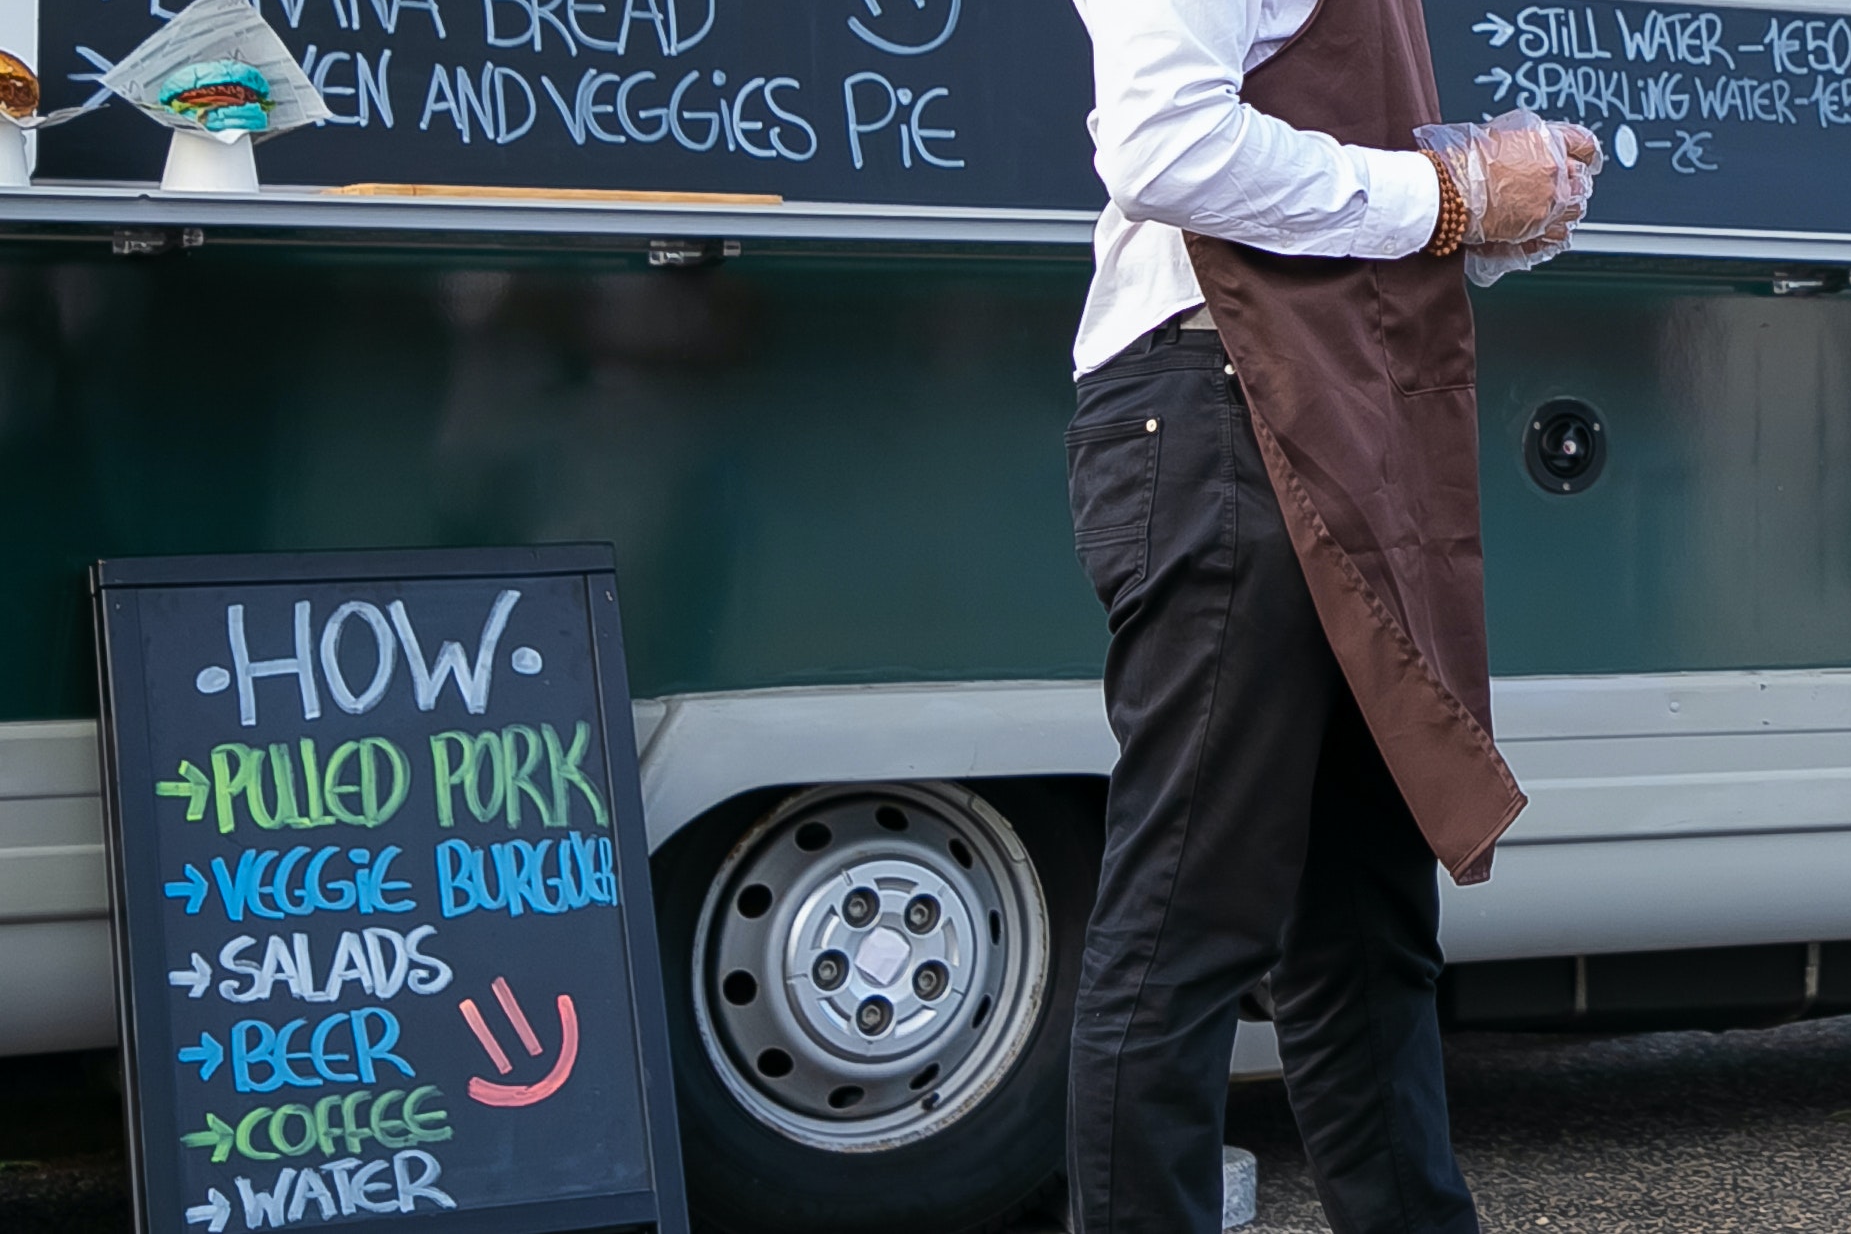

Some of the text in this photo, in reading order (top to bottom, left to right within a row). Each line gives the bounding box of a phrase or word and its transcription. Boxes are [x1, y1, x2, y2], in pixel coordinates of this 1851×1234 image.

[1614, 9, 1736, 70] WATER
[419, 60, 533, 144] AND
[1694, 74, 1796, 125] WATER
[227, 589, 521, 727] HOW
[211, 720, 610, 834] PULLED PORK
[218, 924, 454, 1003] SALADS
[230, 1006, 416, 1093] BEER
[235, 1084, 455, 1161] COFFEE
[234, 1149, 458, 1230] WATER
